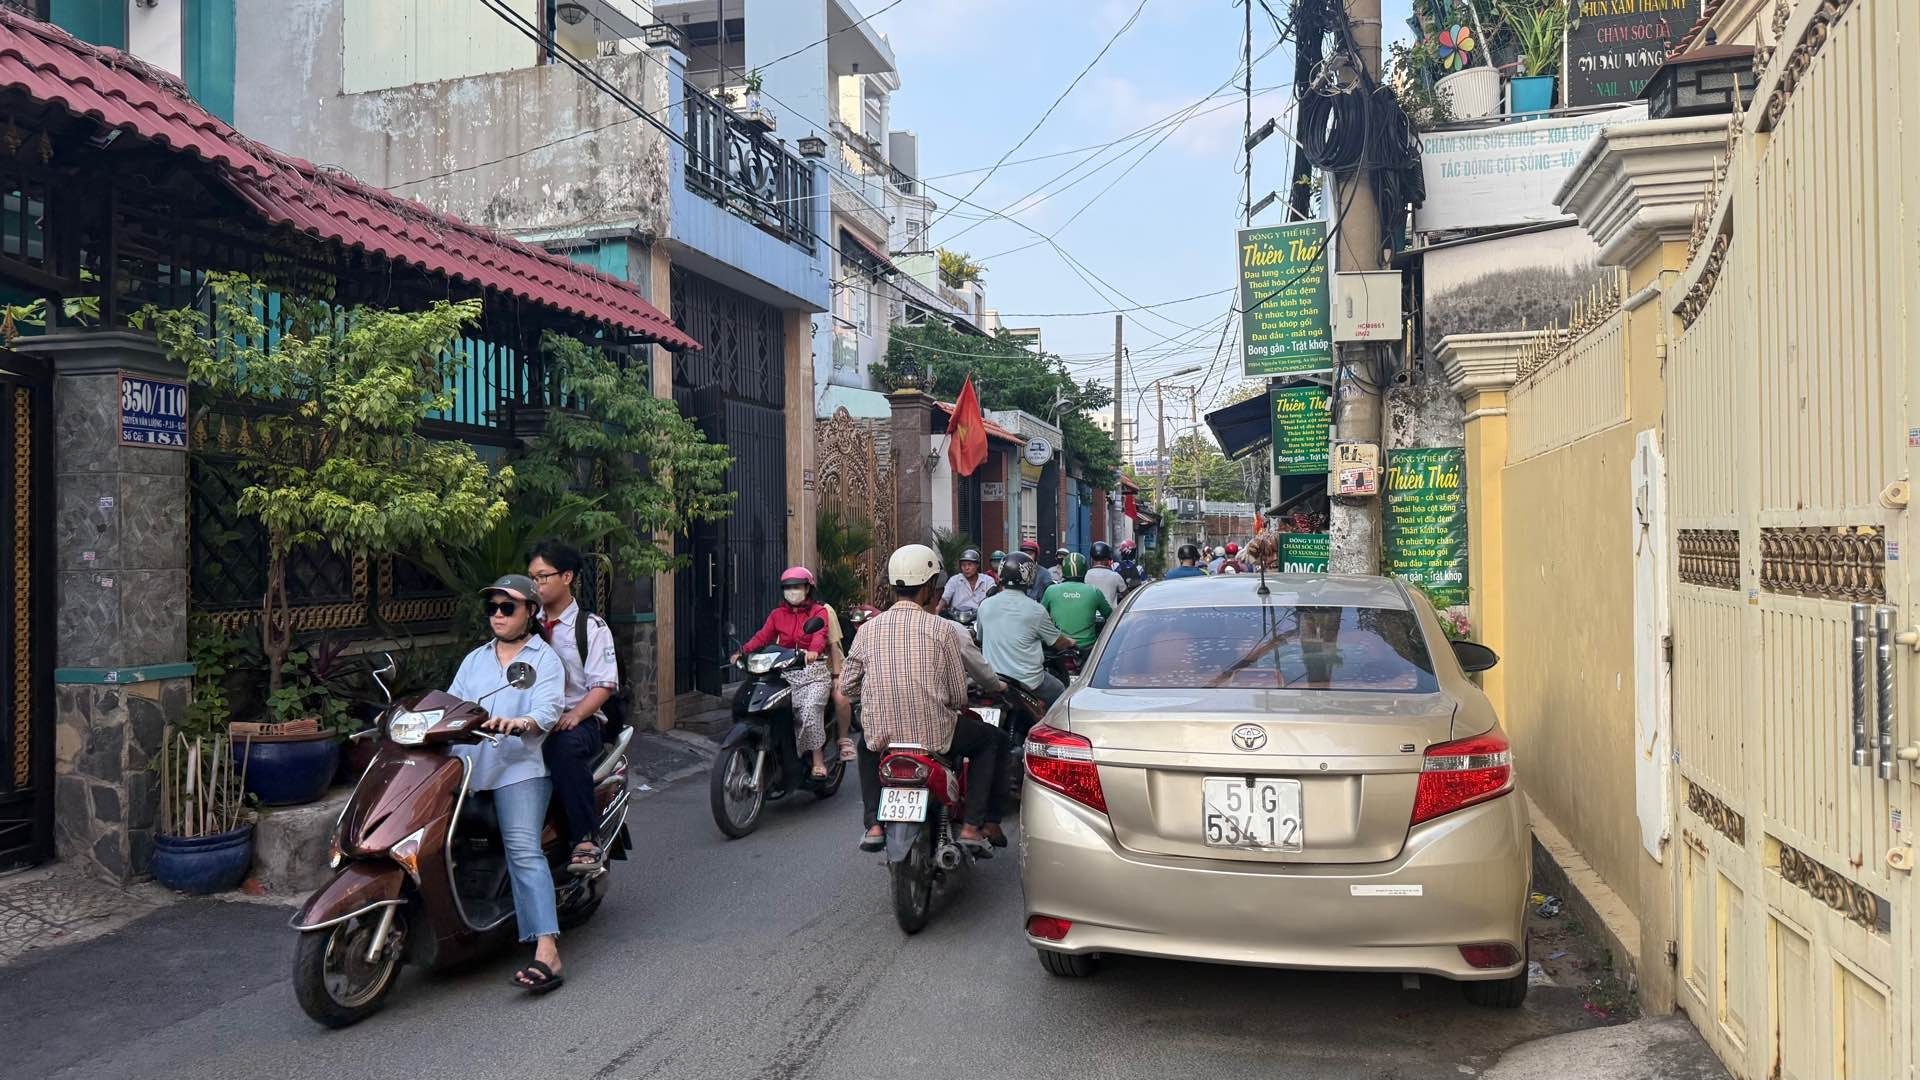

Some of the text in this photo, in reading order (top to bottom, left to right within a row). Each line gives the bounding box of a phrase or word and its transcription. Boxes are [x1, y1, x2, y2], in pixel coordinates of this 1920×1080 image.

[1597, 24, 1628, 43] CHĂM
[1631, 20, 1653, 40] SÓC
[1440, 160, 1460, 178] TÁC
[1497, 155, 1516, 176] CỘT
[1242, 237, 1324, 267] Thiên Thái
[1244, 271, 1260, 279] Đau
[1280, 299, 1297, 308] kinh
[1285, 309, 1298, 319] tay
[1261, 322, 1277, 330] Đau
[1251, 333, 1268, 341] Đau
[1247, 344, 1268, 356] Bong
[1291, 340, 1308, 353] Trật
[1308, 338, 1329, 352] khớp
[122, 380, 187, 418] 350/110
[1276, 396, 1328, 413] Thiên Th
[123, 430, 132, 440] Số
[145, 431, 184, 446] 18A
[1278, 455, 1294, 463] Bong
[1309, 453, 1321, 462] Trật
[1388, 465, 1424, 490] Thiên
[1427, 464, 1459, 488] Thái
[1424, 537, 1436, 546] tay
[1402, 548, 1417, 556] Đau
[1283, 561, 1315, 573] BONG
[1393, 560, 1408, 568] Đau
[1444, 570, 1462, 583] khớp
[1063, 591, 1081, 599] Grab
[887, 790, 920, 804] 84-G1
[881, 804, 922, 819] 439.71
